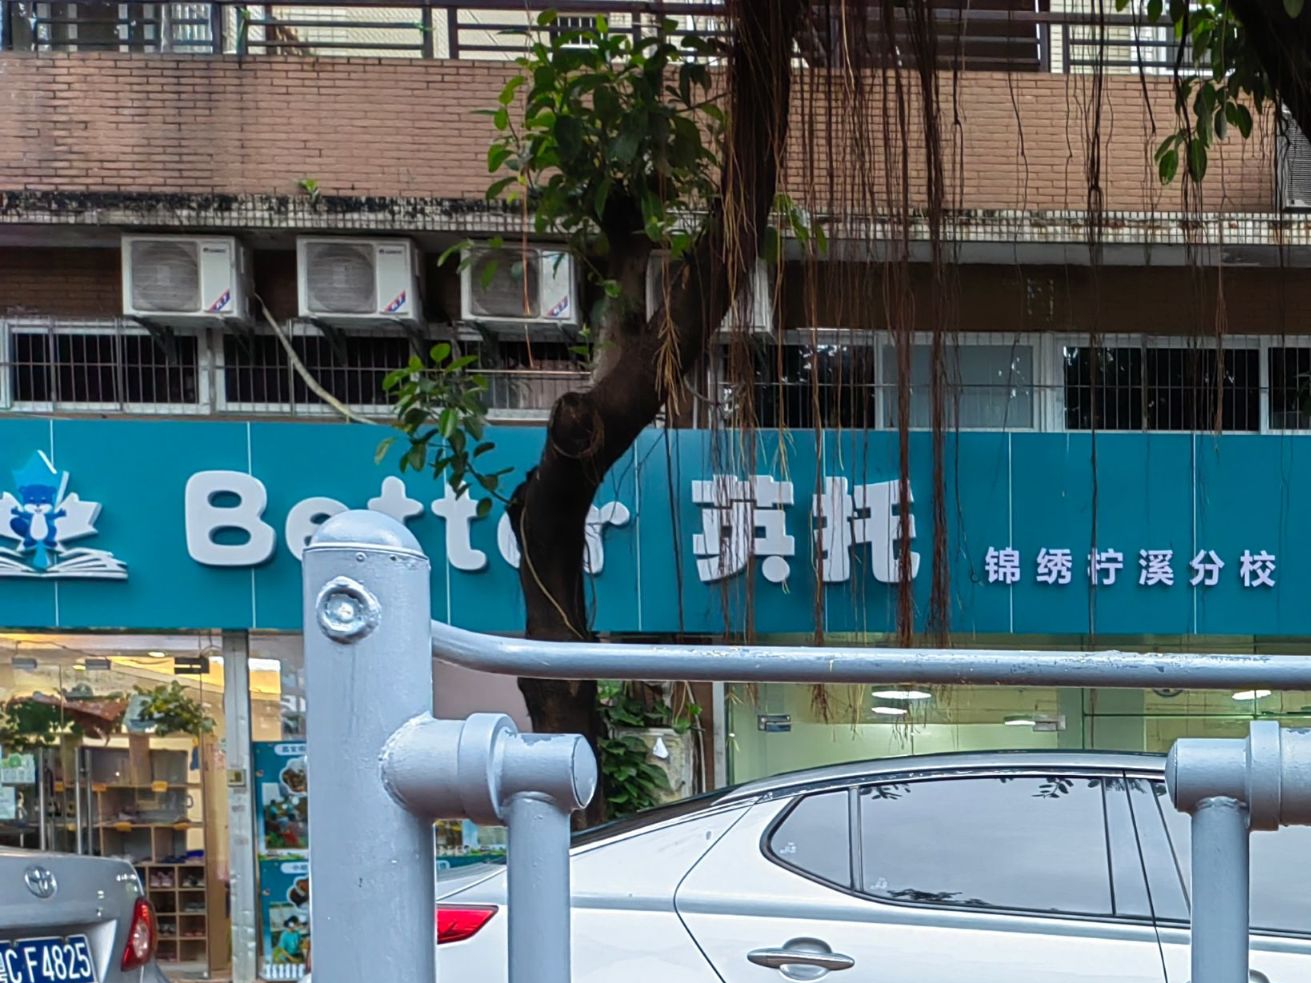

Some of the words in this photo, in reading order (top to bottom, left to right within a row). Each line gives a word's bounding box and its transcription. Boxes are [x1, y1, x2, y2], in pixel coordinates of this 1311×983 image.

[184, 469, 631, 575] Bettr
[984, 546, 1277, 588] 锦绣柠溪分校
